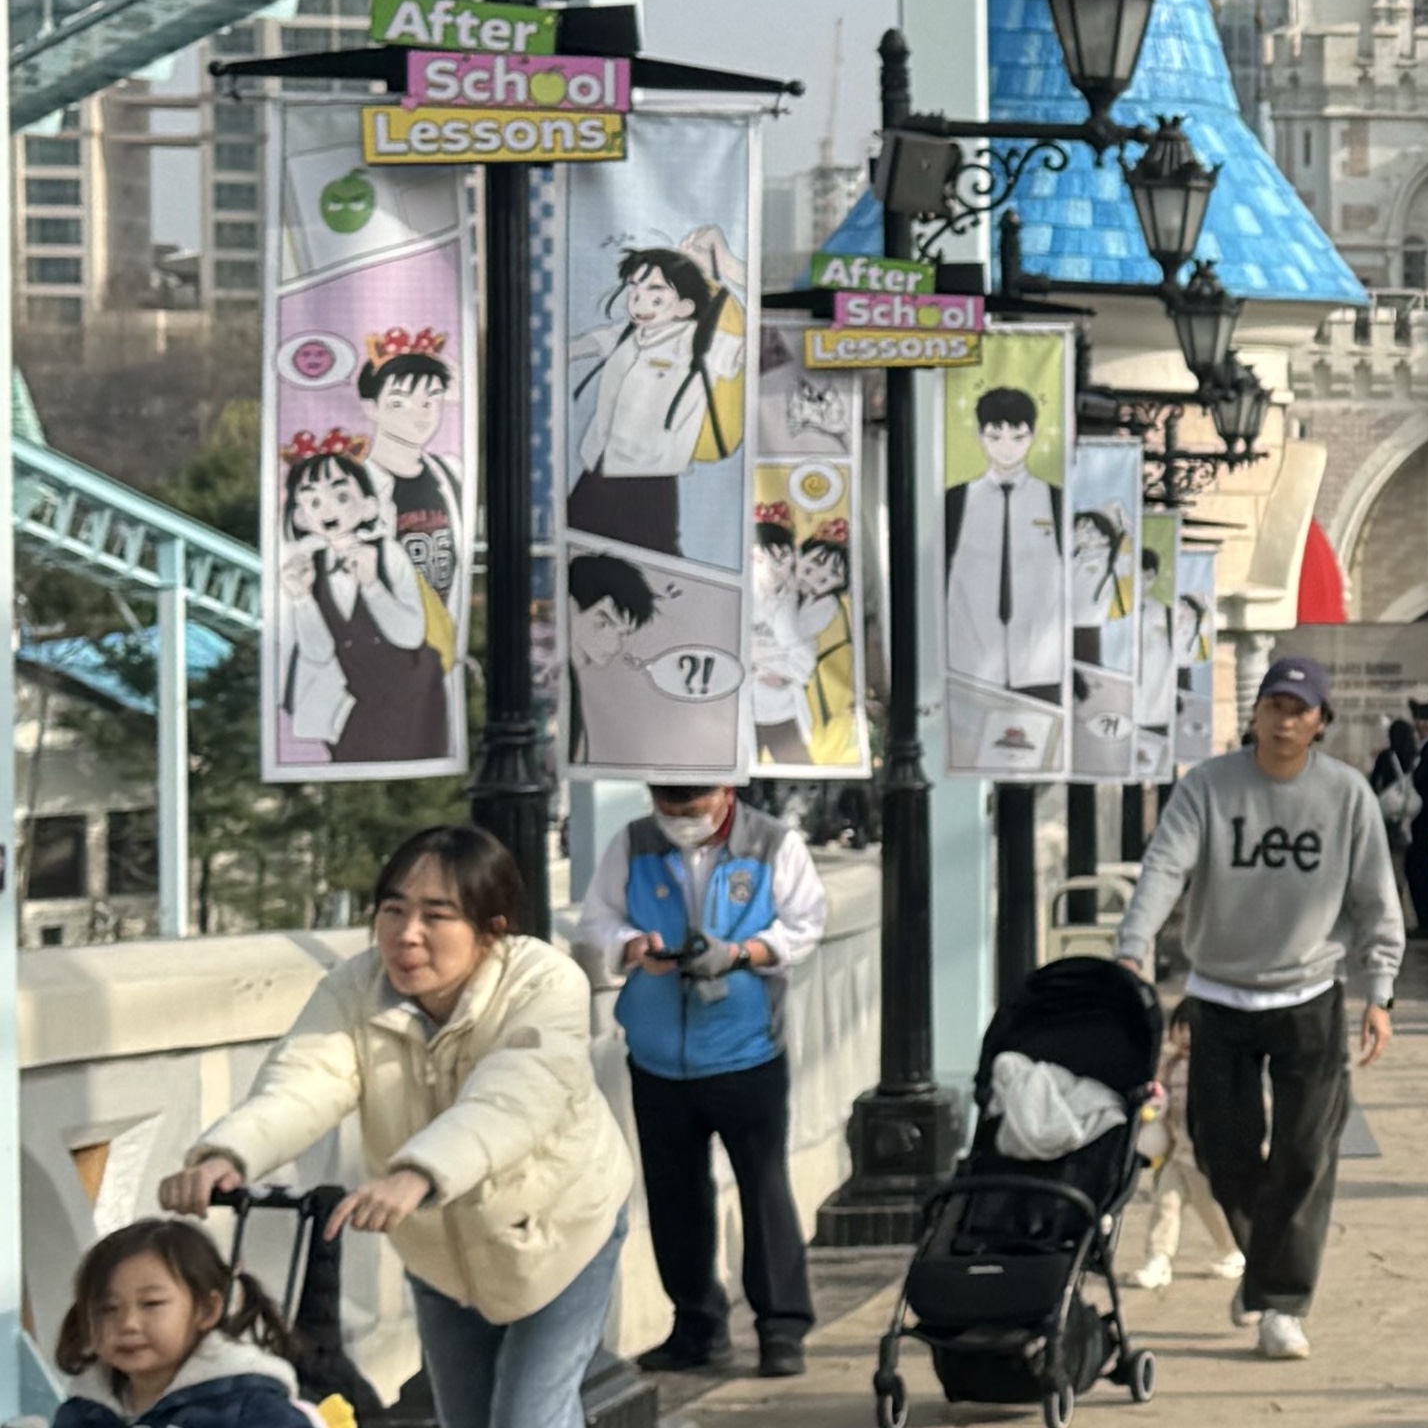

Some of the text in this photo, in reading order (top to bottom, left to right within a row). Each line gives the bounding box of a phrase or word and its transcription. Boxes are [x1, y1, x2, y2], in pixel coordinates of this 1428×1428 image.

[374, 112, 607, 154] Lessons
[820, 257, 923, 293] After
[813, 334, 968, 361] Lessons
[1231, 816, 1322, 872] Lee
